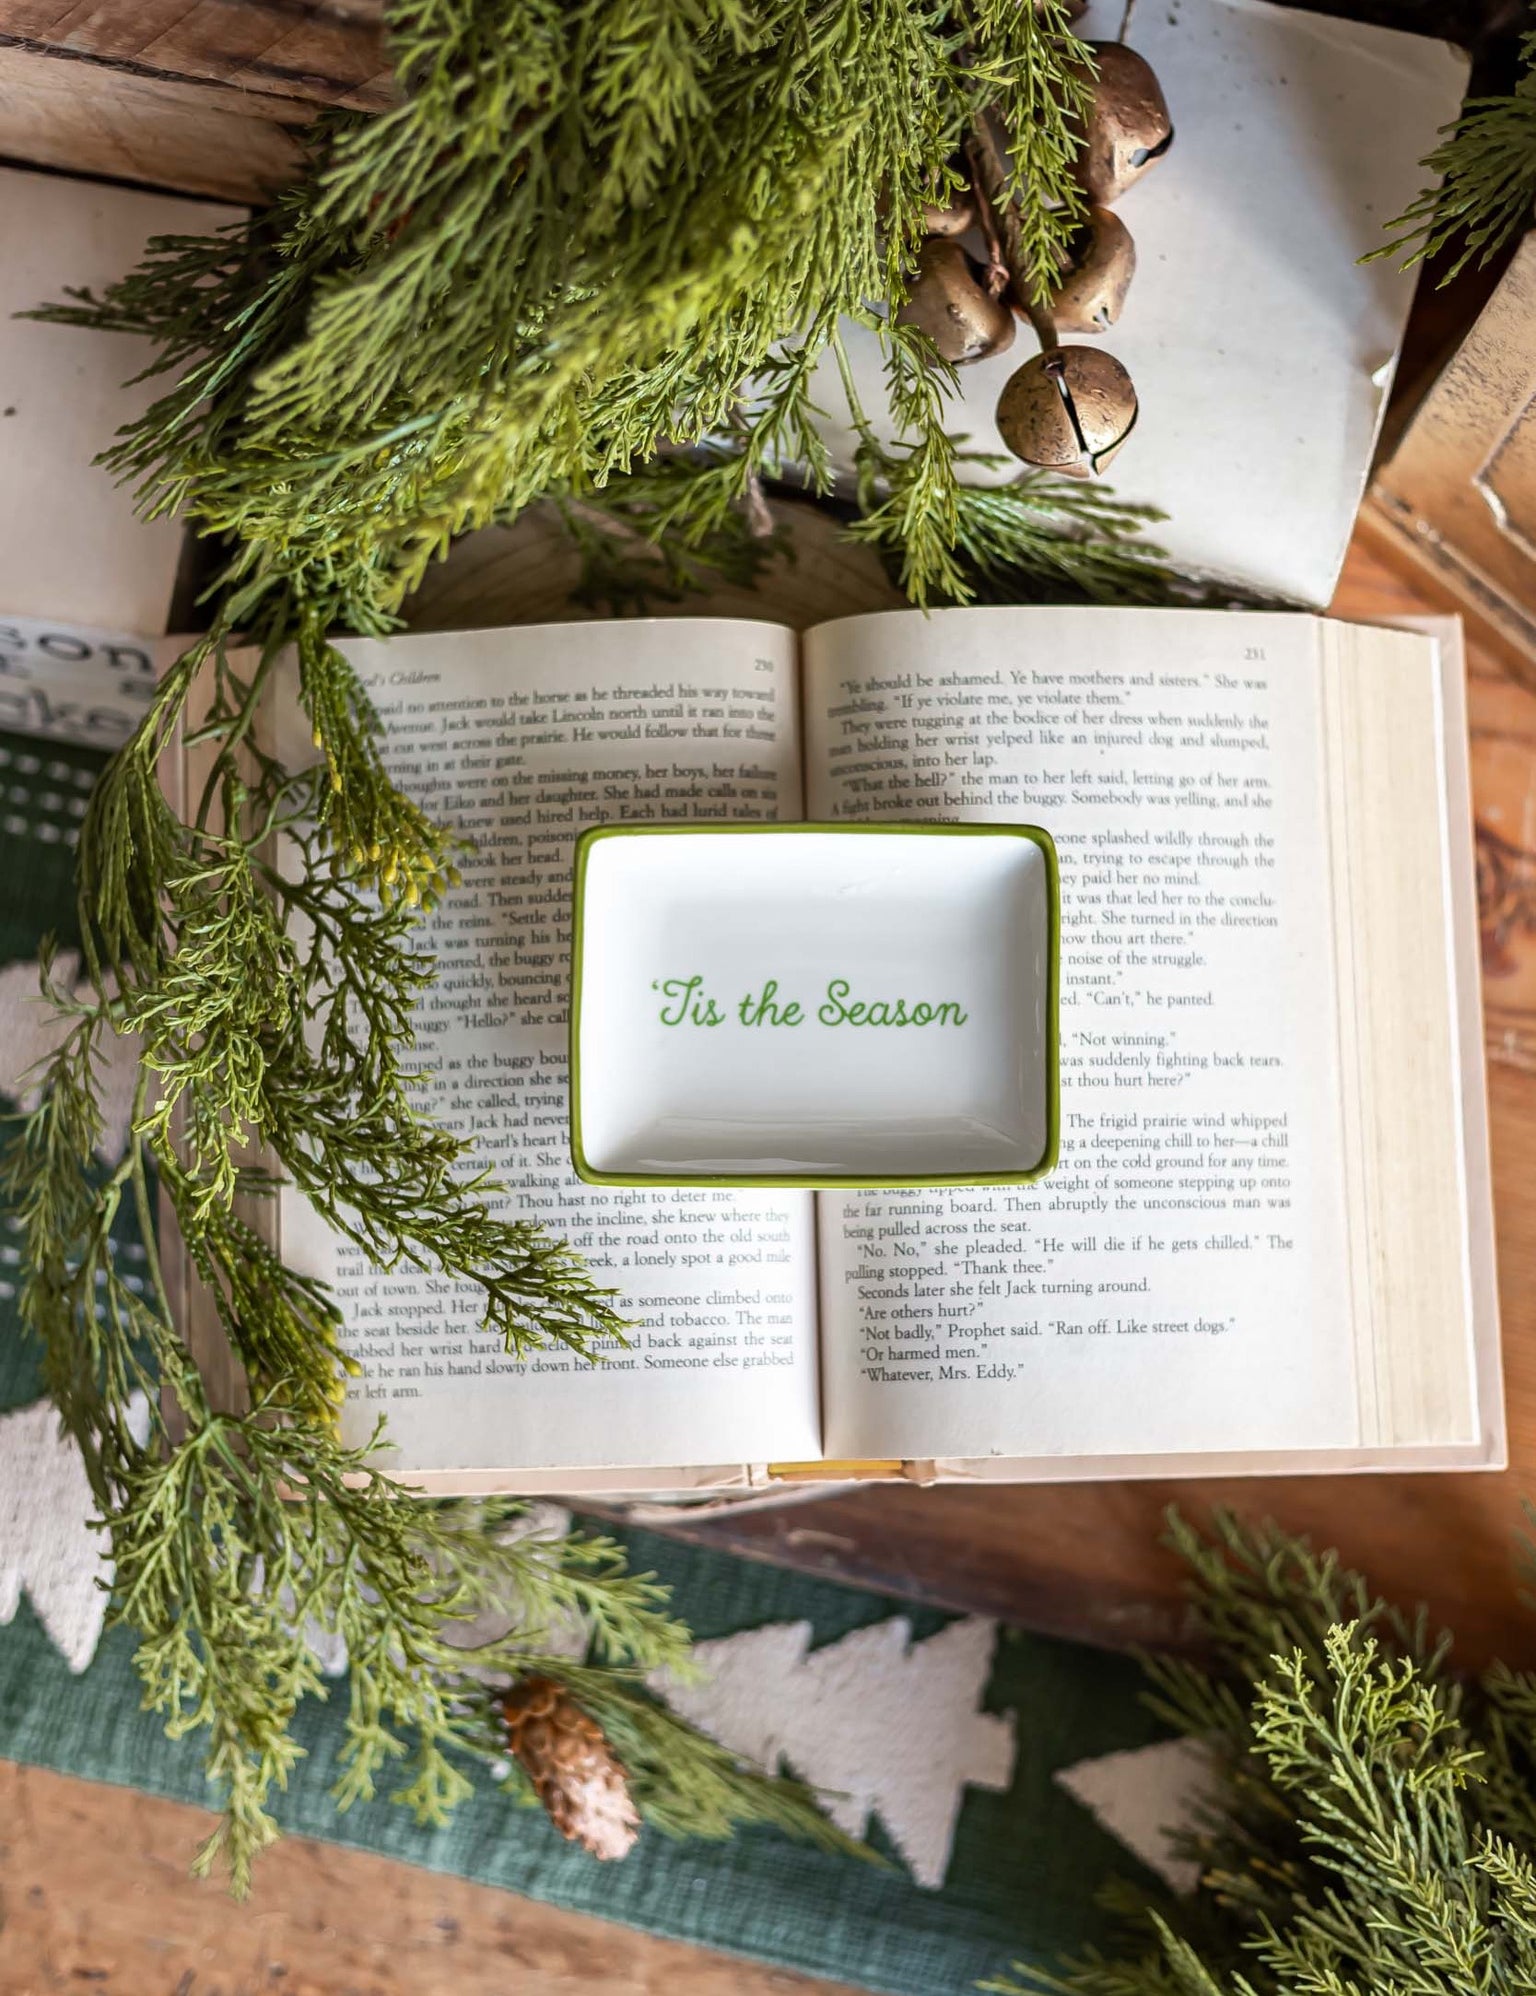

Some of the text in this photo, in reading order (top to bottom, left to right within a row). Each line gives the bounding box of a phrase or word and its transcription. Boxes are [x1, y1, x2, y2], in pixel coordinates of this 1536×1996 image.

[390, 670, 441, 686] Children
[865, 673, 912, 692] should
[916, 672, 933, 687] be
[1012, 671, 1027, 685] Ye
[1032, 671, 1064, 685] have
[1069, 671, 1124, 685] mothers
[1129, 671, 1154, 686] and
[1214, 674, 1238, 689] She
[456, 777, 487, 789] were
[491, 775, 508, 786] on
[512, 769, 533, 784] the
[538, 766, 588, 786] missing
[645, 764, 668, 779] her
[712, 763, 735, 777] her
[1090, 830, 1275, 850] splashed wildly through the
[410, 928, 551, 954] Jack was turning his
[1068, 950, 1207, 968] noise of the struggle.
[498, 969, 561, 991] bouncing
[651, 975, 968, 1027] 'Tis the Season
[1146, 990, 1162, 1004] he
[1167, 990, 1215, 1008] panted.
[410, 1015, 450, 1035] buggy
[520, 1009, 544, 1025] she
[1088, 1051, 1284, 1070] suddenly fighting back tears.
[450, 1092, 564, 1111] she called, trying
[1066, 1112, 1288, 1130] The frigid prairie wind whipped
[476, 1132, 557, 1149] Pearl's heart
[1080, 1138, 1087, 1147] a
[1090, 1133, 1160, 1151] deepening
[1164, 1133, 1192, 1147] chill
[1196, 1136, 1210, 1147] to
[1261, 1132, 1289, 1146] chill
[1044, 1173, 1291, 1192] weight of someone stepping up onto
[516, 1192, 553, 1207] Thou
[558, 1192, 585, 1206] hast
[590, 1196, 608, 1206] no
[614, 1190, 646, 1209] right
[651, 1192, 666, 1204] to
[671, 1188, 706, 1203] deter
[844, 1194, 1291, 1219] the far running board. Then abruptly the unconscious man was
[574, 1227, 791, 1246] off the road onto the old south
[934, 1240, 958, 1254] she
[966, 1238, 1026, 1258] pleaded.
[1072, 1236, 1096, 1251] will
[1104, 1236, 1125, 1250] die
[1132, 1236, 1141, 1250] if
[1148, 1236, 1165, 1250] he
[1172, 1238, 1198, 1254] gets
[1270, 1235, 1294, 1249] The
[620, 1289, 793, 1307] as someone climbed onto
[858, 1278, 1152, 1299] Seconds later she felt Jack turning around.
[354, 1302, 382, 1321] Jack
[388, 1299, 445, 1320] stopped.
[452, 1298, 477, 1313] Her
[891, 1303, 933, 1319] others
[948, 1322, 1005, 1341] Prophet
[1010, 1321, 1042, 1336] said.
[1088, 1320, 1110, 1334] off.
[1117, 1319, 1148, 1333] Like
[1152, 1321, 1189, 1333] street
[402, 1339, 500, 1357] her wrist hard
[888, 1344, 940, 1360] harmed
[939, 1364, 970, 1379] Mrs.
